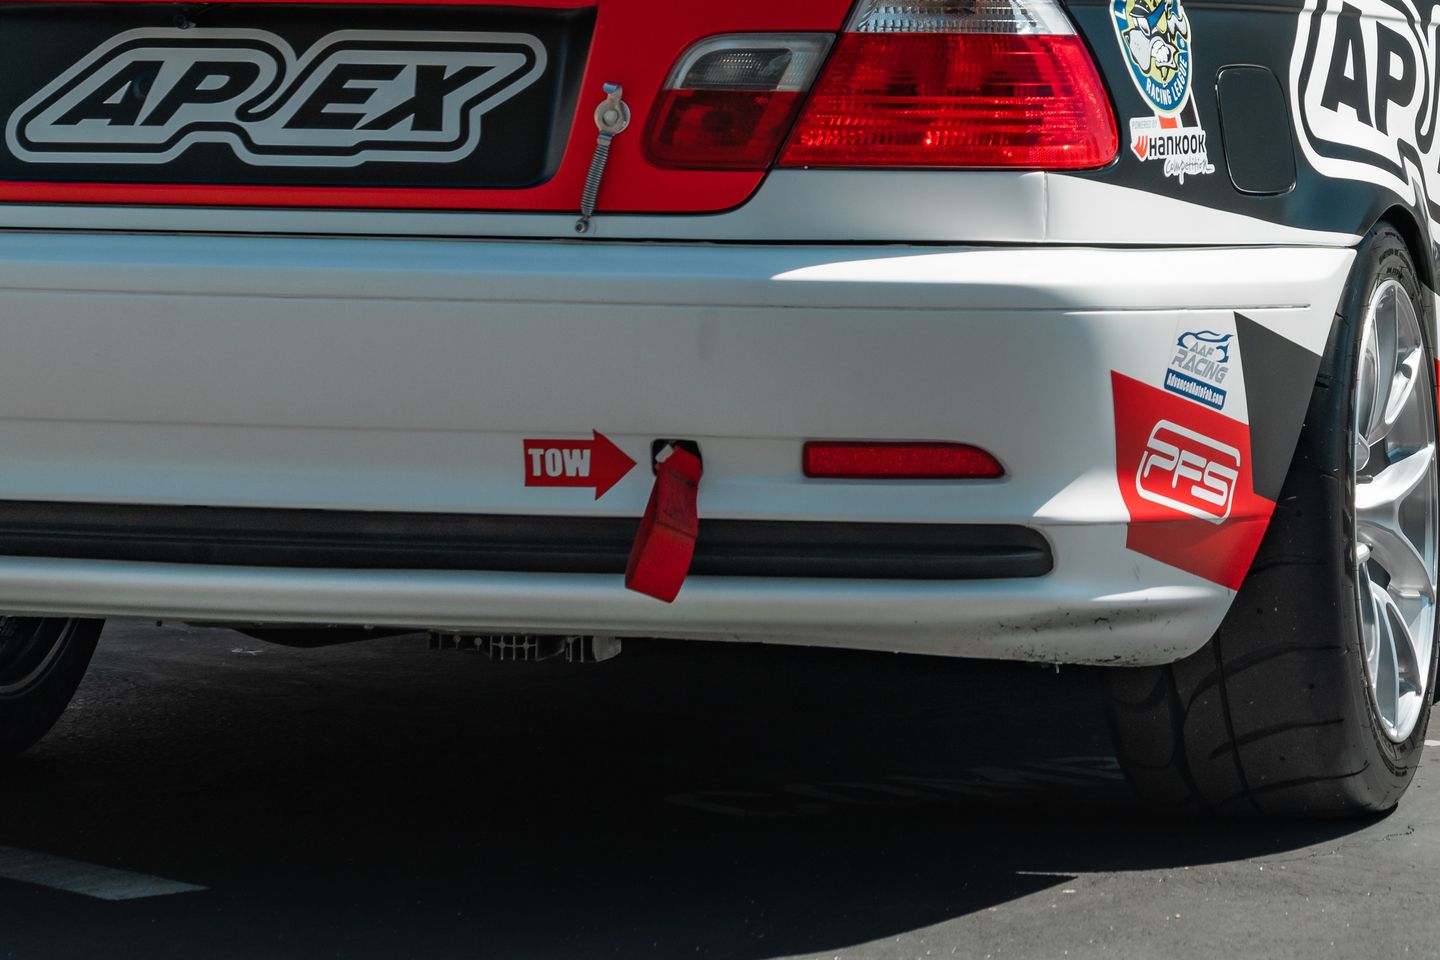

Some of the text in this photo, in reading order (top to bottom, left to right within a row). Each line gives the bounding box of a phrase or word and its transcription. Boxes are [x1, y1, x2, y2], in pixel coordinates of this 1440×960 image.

[53, 61, 497, 132] APEX
[1145, 55, 1187, 105] RACING LEAGUE
[1171, 348, 1229, 384] RACING
[1189, 342, 1214, 356] AAF
[528, 448, 591, 478] TOW
[1143, 438, 1238, 506] PFS
